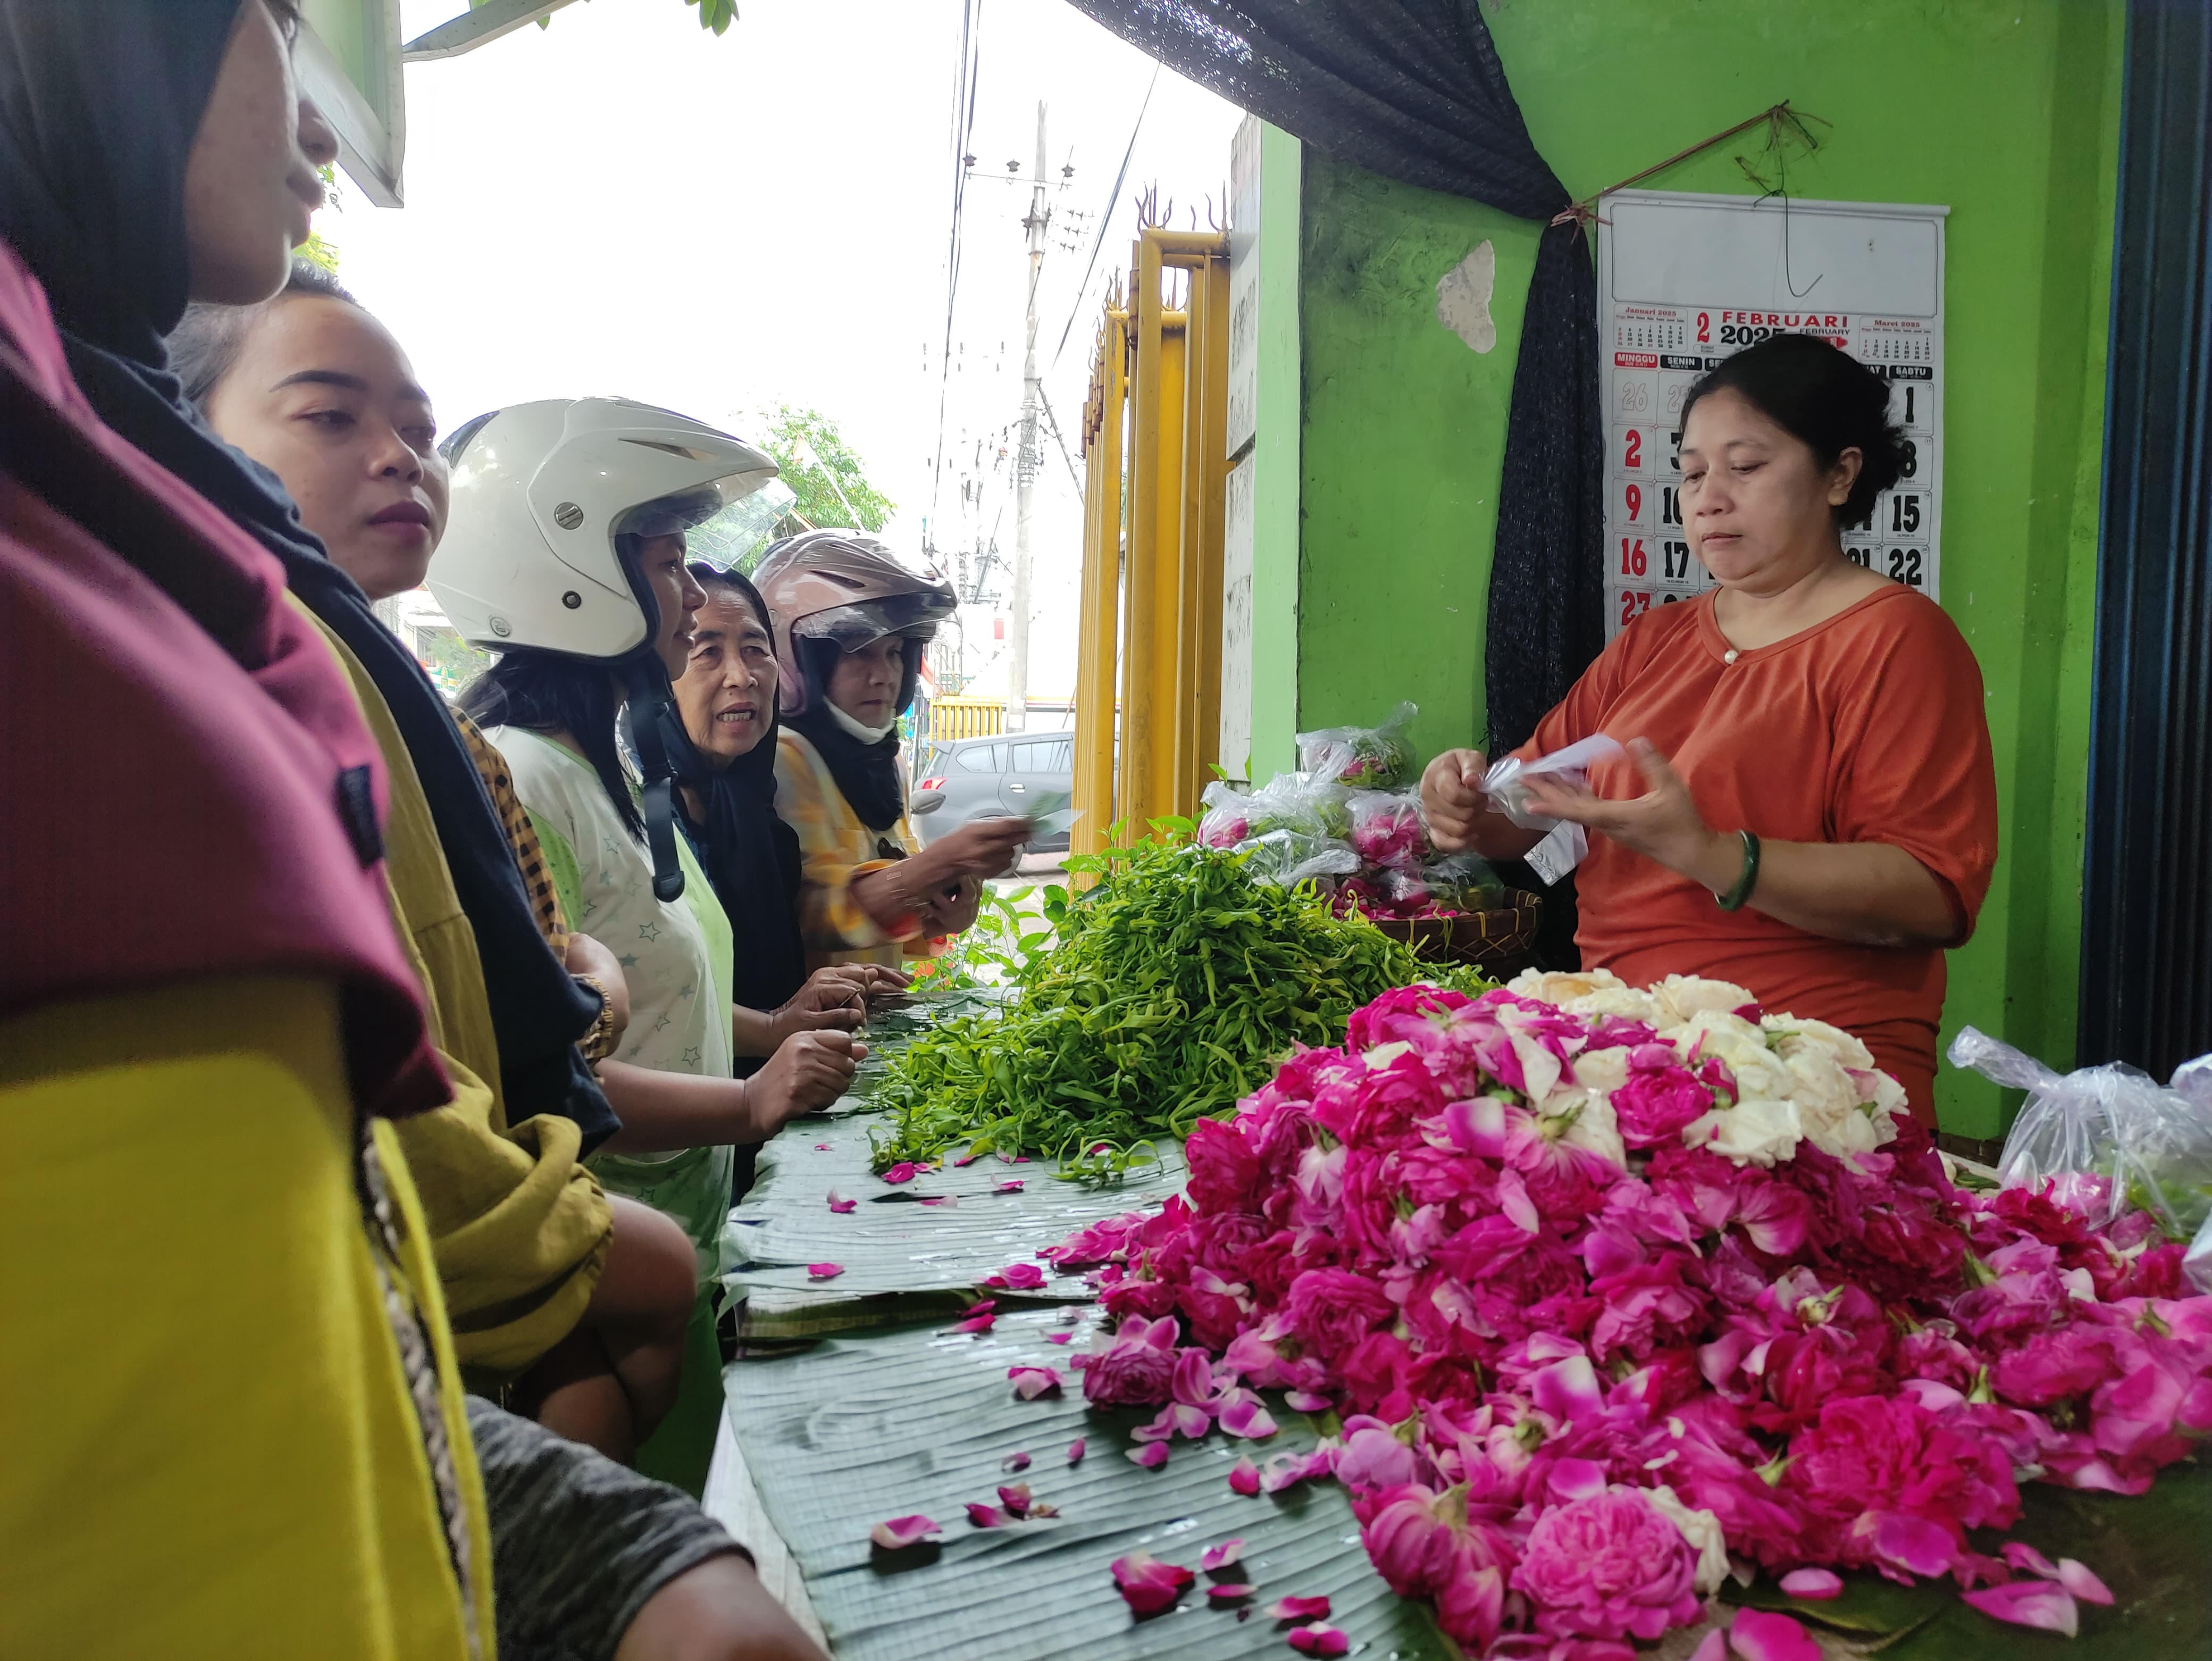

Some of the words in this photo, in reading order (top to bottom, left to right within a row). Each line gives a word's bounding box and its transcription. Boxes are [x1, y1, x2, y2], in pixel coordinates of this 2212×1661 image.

[1697, 312, 1710, 343] 2
[1723, 311, 1847, 328] FEBRUARI
[1721, 325, 1786, 346] 202
[1617, 354, 1655, 363] MINGGU
[1667, 357, 1695, 365] SENIN
[1896, 365, 1926, 375] SABTU
[1622, 382, 1648, 412] 26
[1906, 387, 1914, 422] 1
[1625, 429, 1641, 468] 2
[1626, 484, 1641, 521] 9
[1892, 495, 1920, 532] 15
[1622, 538, 1647, 576] 16
[1664, 541, 1689, 578] 17
[1889, 548, 1922, 586] 22
